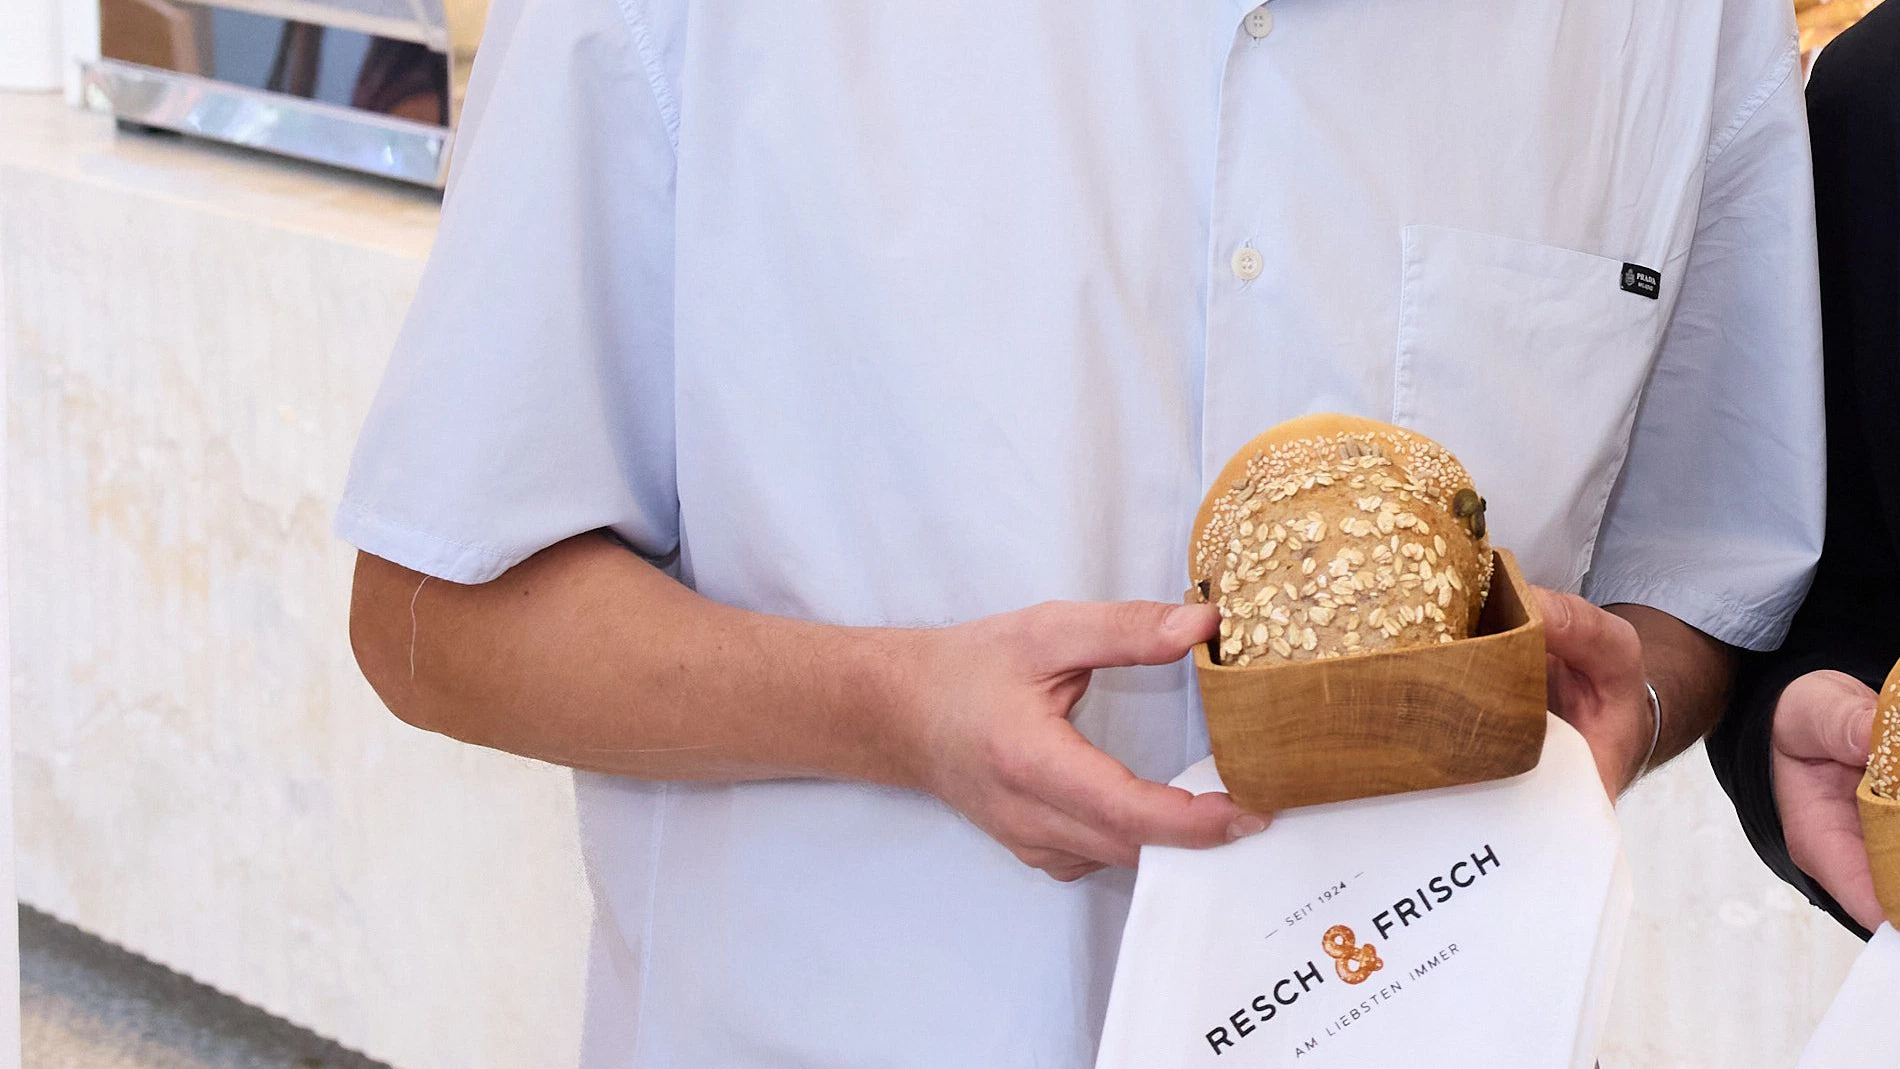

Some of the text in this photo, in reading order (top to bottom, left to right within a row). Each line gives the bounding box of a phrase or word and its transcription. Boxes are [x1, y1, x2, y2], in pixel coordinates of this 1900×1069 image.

[1204, 843, 1501, 1056] RESCH & FRISCH
[1284, 880, 1347, 927] SEIT 1924
[1294, 942, 1460, 1059] AM LIEBSTEN IMMER
